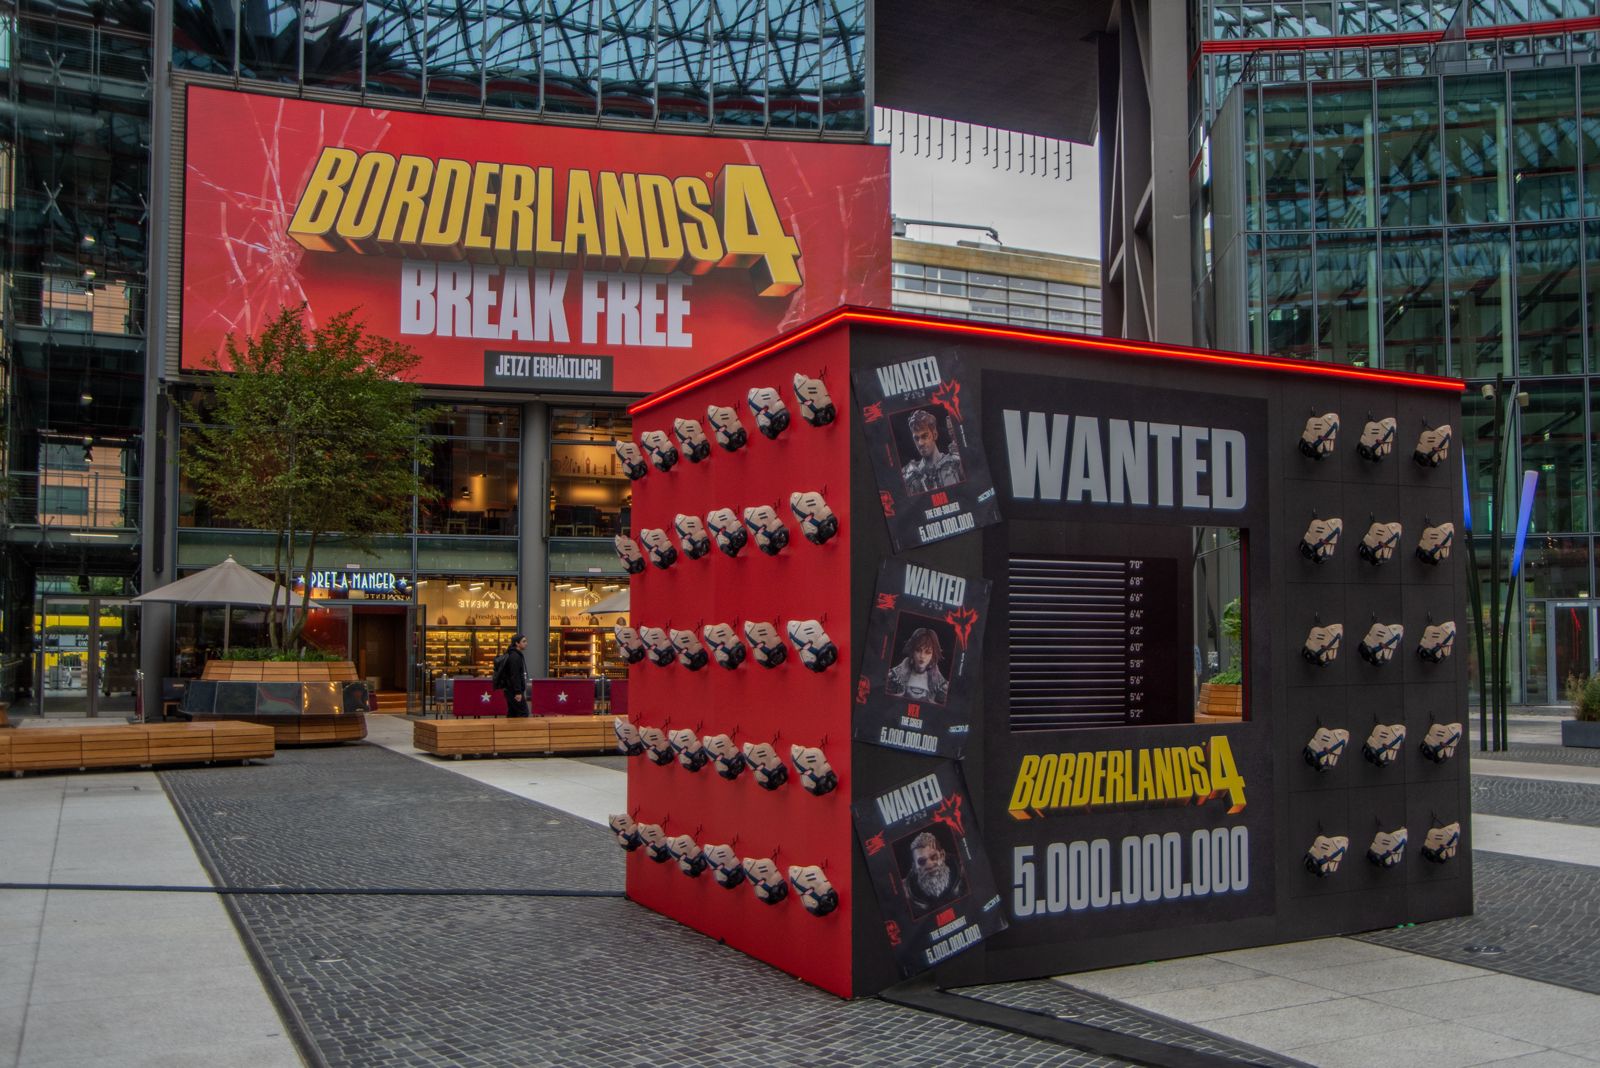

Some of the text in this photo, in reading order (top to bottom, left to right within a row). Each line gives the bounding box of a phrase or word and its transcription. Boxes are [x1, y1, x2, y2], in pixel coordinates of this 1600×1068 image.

[289, 146, 804, 293] BORDERLANDS 4
[400, 262, 693, 348] BREAK FREE
[495, 355, 602, 381] JETZT ERHÄLTLICH
[876, 355, 942, 398] WANTED
[1002, 409, 1247, 510] WANTED
[311, 571, 396, 590] PRET A MANGER
[904, 563, 967, 607] WANTED
[876, 773, 943, 826] WANTED
[1008, 735, 1247, 815] BORDERLANDS 4
[1013, 825, 1250, 917] 5.000.000.000
